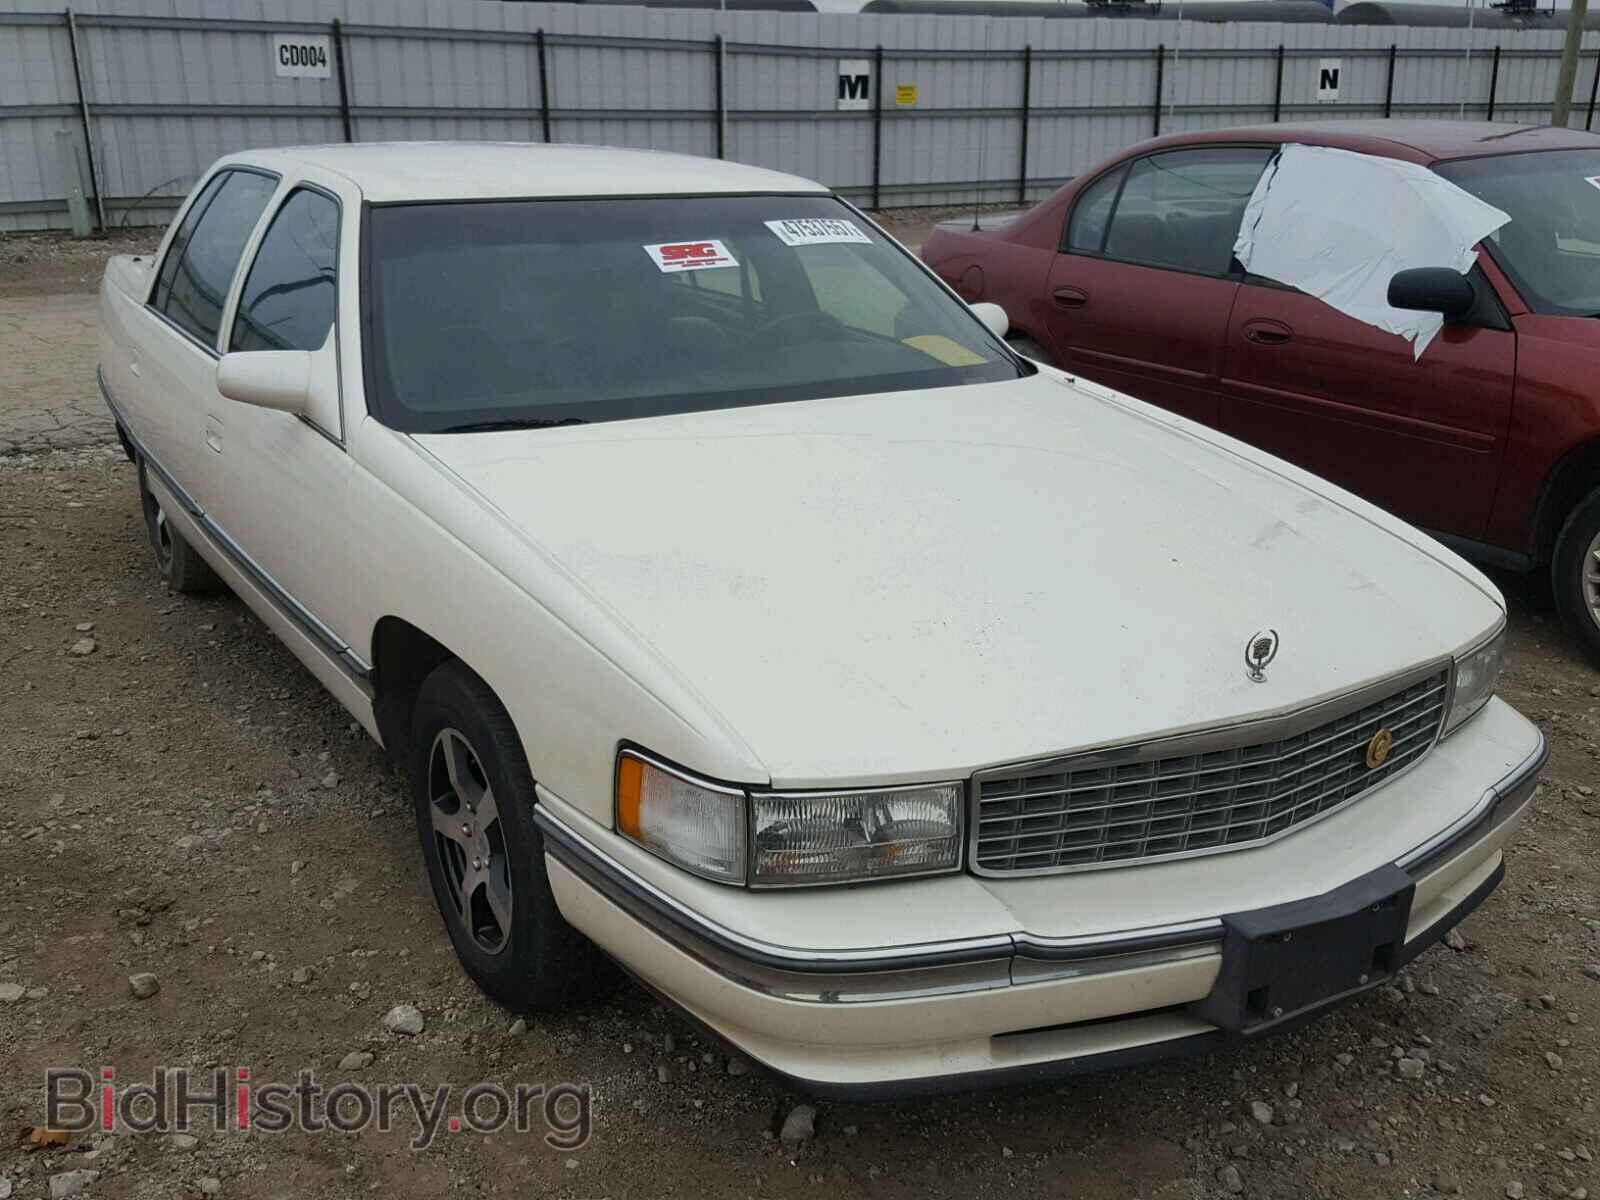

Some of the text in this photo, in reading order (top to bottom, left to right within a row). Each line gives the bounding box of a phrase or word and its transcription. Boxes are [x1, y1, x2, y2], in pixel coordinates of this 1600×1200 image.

[280, 44, 326, 67] CD004
[839, 74, 869, 100] M
[1320, 68, 1339, 90] N
